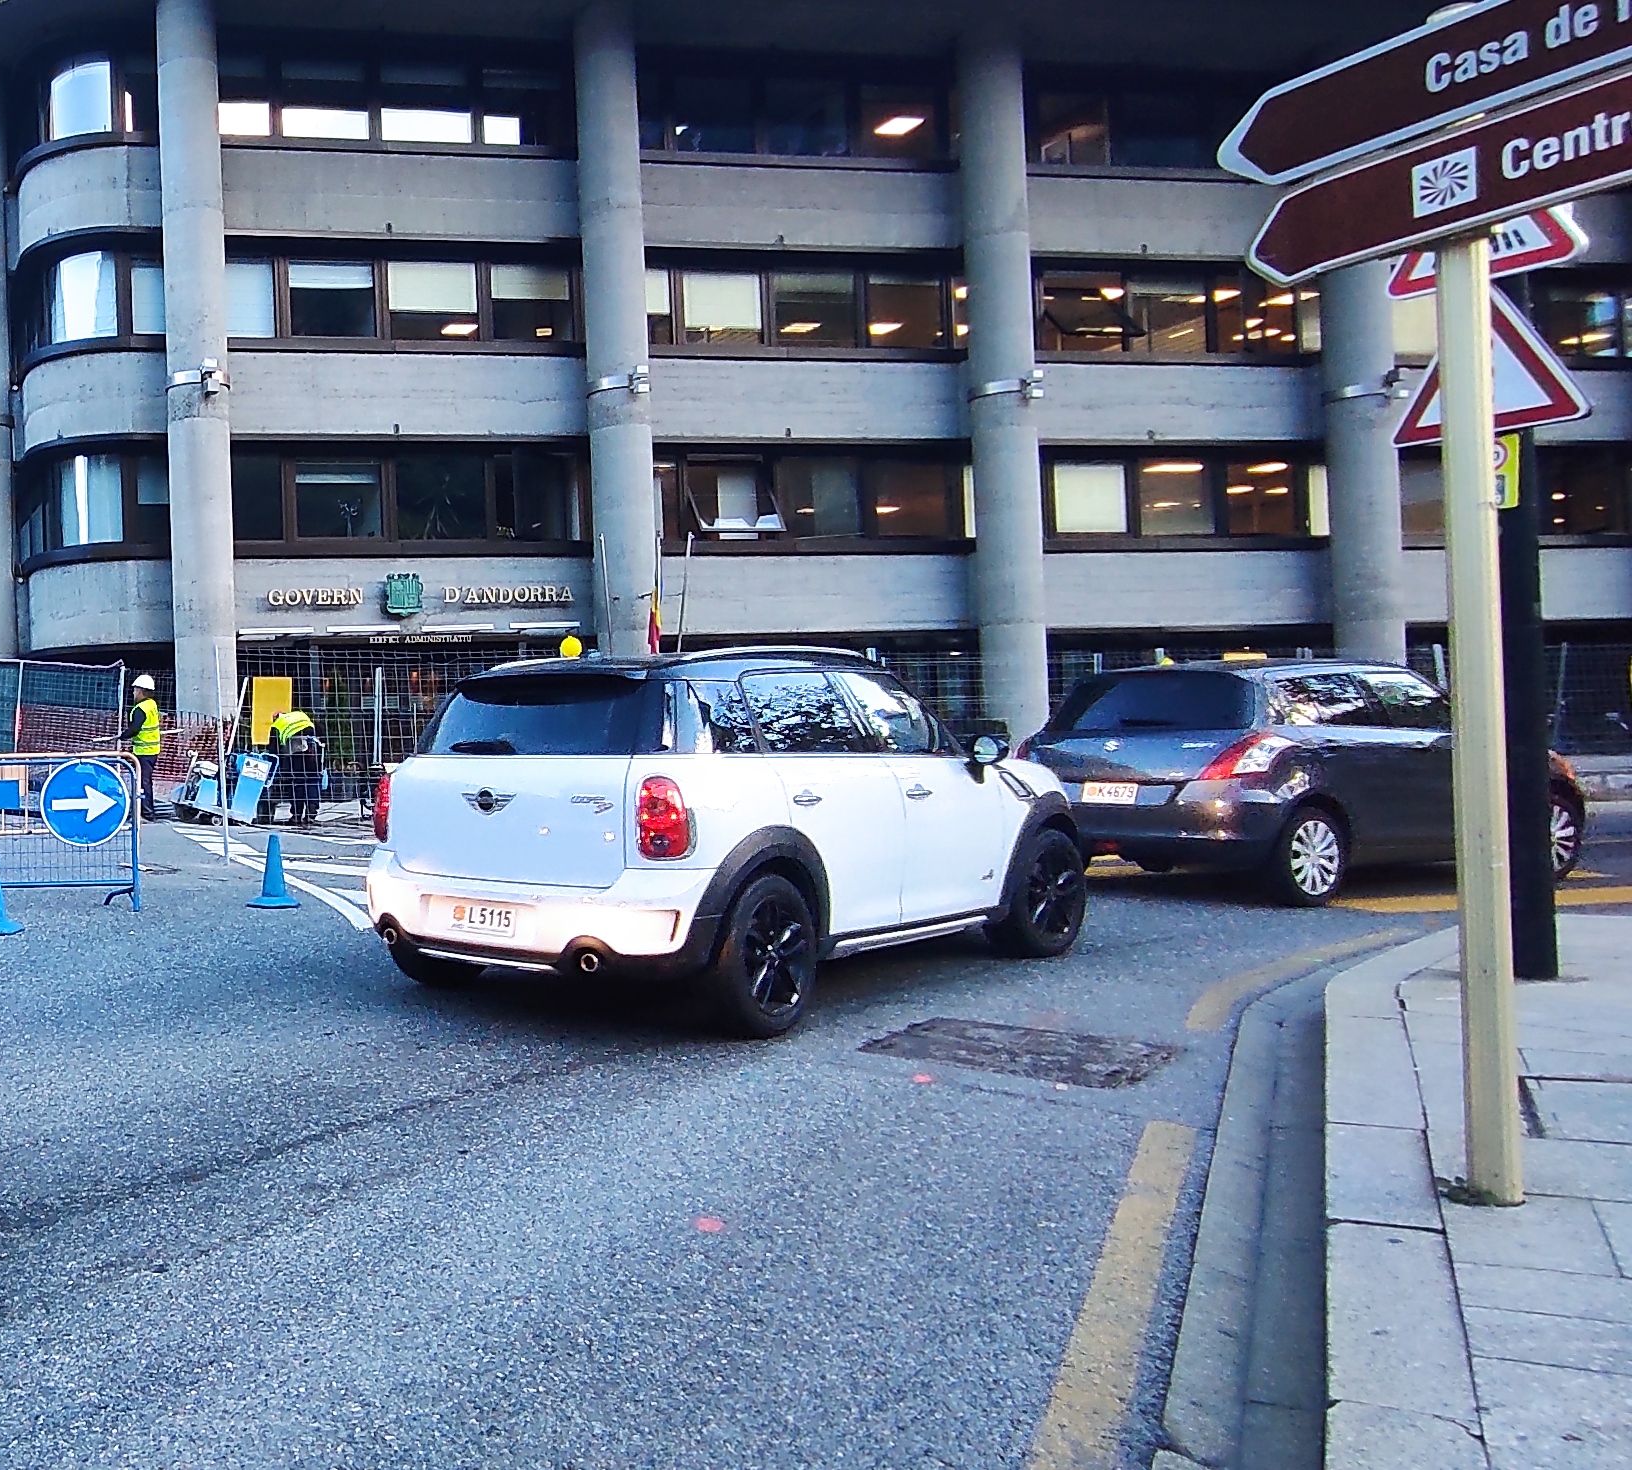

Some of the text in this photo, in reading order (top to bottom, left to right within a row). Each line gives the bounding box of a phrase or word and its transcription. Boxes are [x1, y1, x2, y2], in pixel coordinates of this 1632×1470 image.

[1425, 30, 1529, 93] Casa
[1545, 3, 1600, 49] de
[1501, 111, 1631, 180] Centr
[267, 586, 575, 606] GOVERN D'ANDORRA
[369, 634, 473, 644] EDIFICI ADMINISTRATIU
